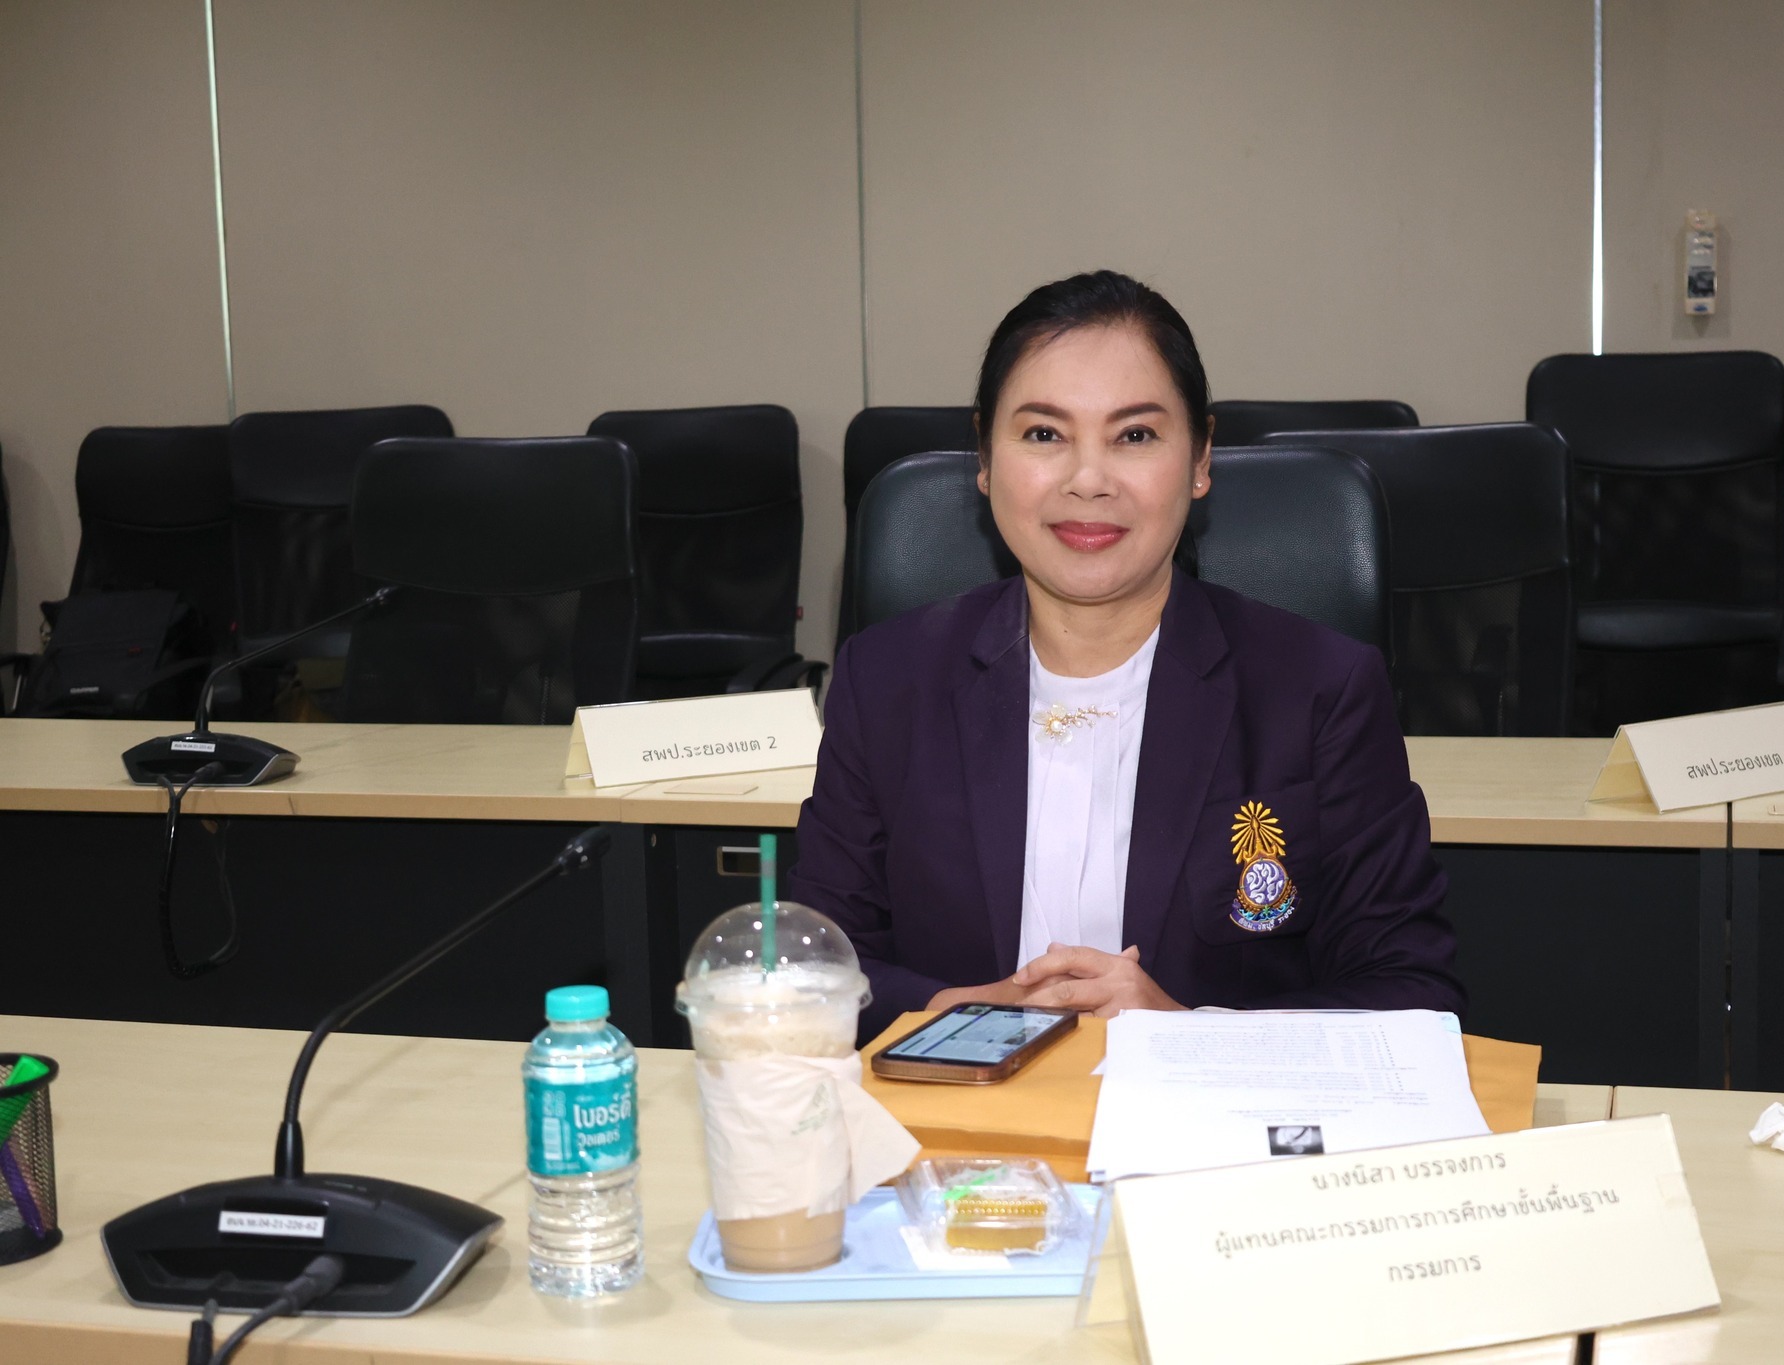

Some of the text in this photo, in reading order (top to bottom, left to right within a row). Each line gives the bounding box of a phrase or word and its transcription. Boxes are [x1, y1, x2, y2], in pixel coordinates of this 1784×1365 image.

[642, 735, 777, 762] สพป.ระยองเขต 2
[1686, 752, 1784, 779] สพป.ระยองเขต
[1312, 1151, 1507, 1190] นางนิสา บรรจงการ
[1387, 1253, 1482, 1283] กรรมการ
